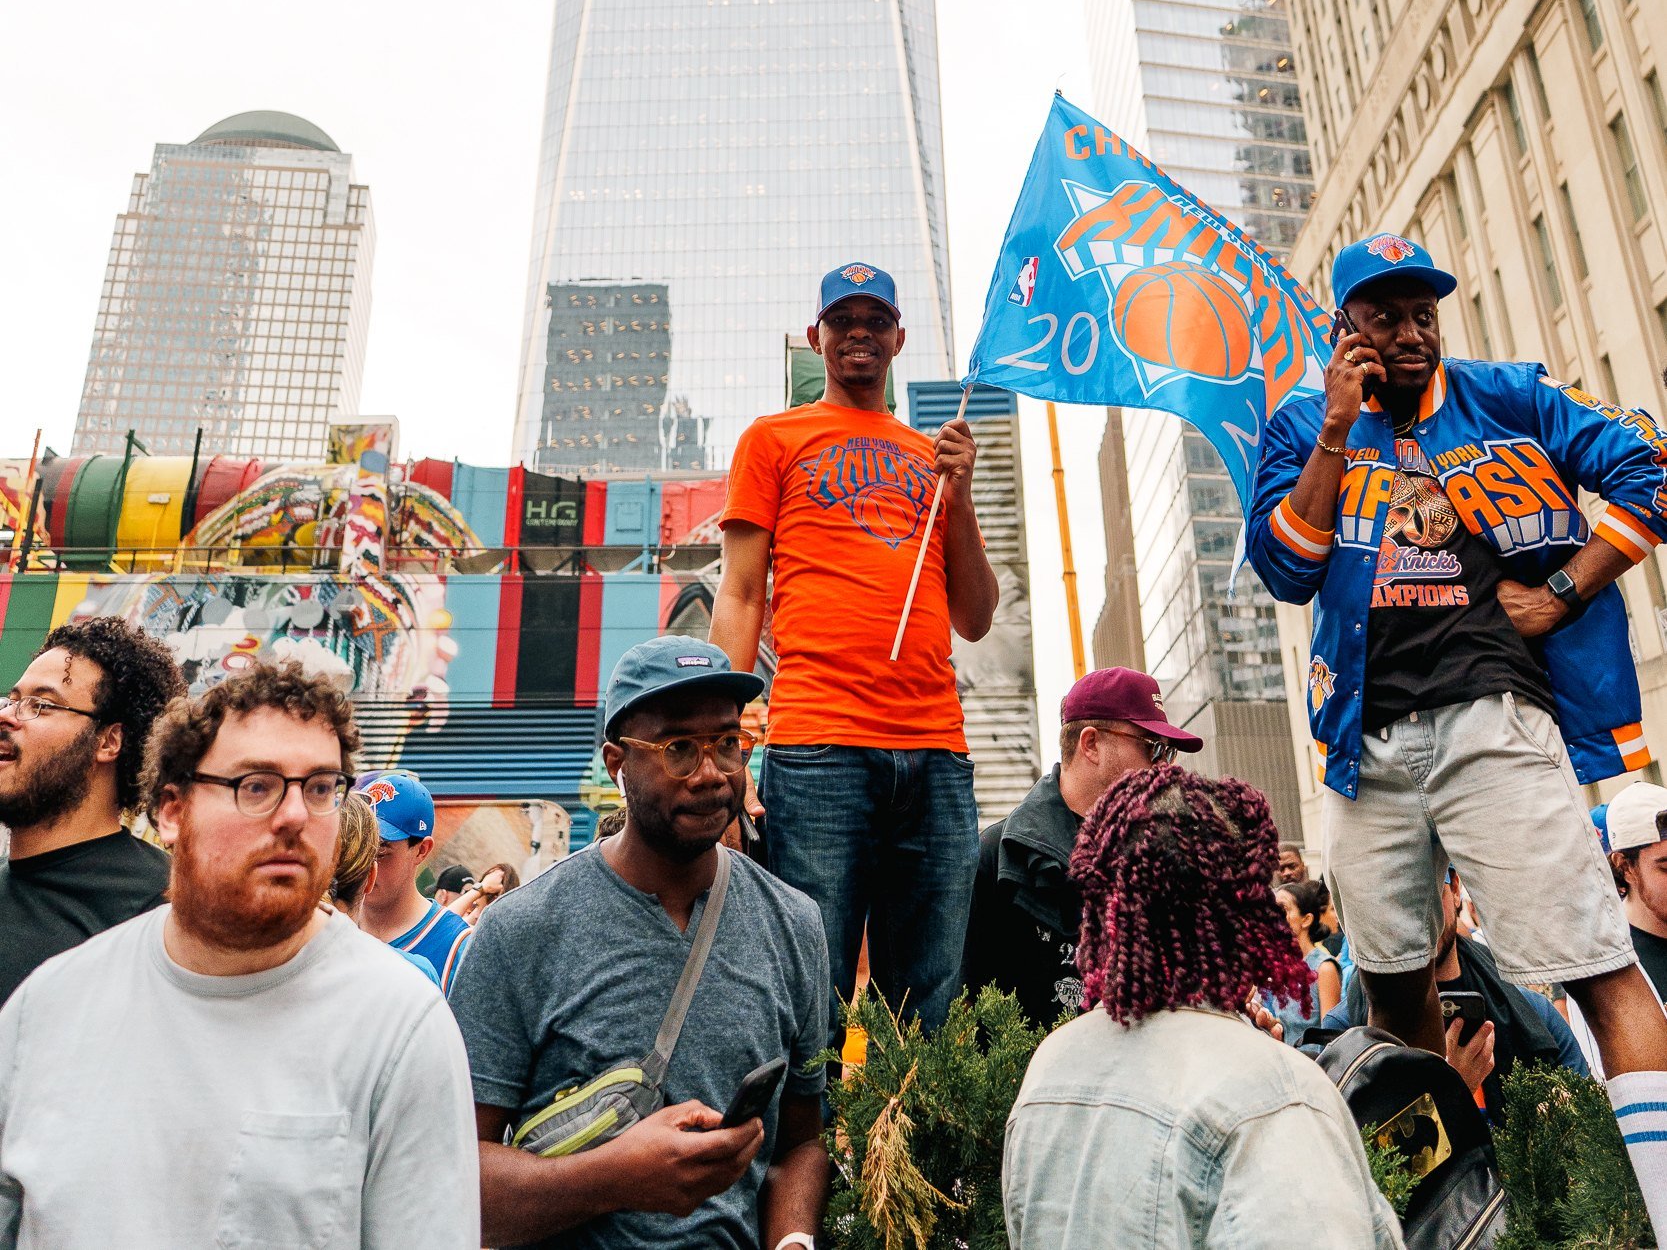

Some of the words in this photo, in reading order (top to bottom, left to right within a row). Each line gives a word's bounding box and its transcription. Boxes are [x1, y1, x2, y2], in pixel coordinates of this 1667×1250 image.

[1171, 196, 1222, 231] NEW
[1227, 232, 1279, 286] YORK
[1058, 184, 1312, 422] KNICKS
[994, 311, 1101, 376] 20
[1221, 398, 1259, 474] 2
[847, 437, 870, 449] NEW
[872, 438, 901, 454] YORK
[1344, 447, 1380, 461] NEW
[1435, 444, 1485, 471] YORK
[808, 447, 942, 500] KNICKS
[526, 500, 576, 519] HG
[1430, 510, 1454, 528] 1973
[1392, 547, 1457, 570] Knicks
